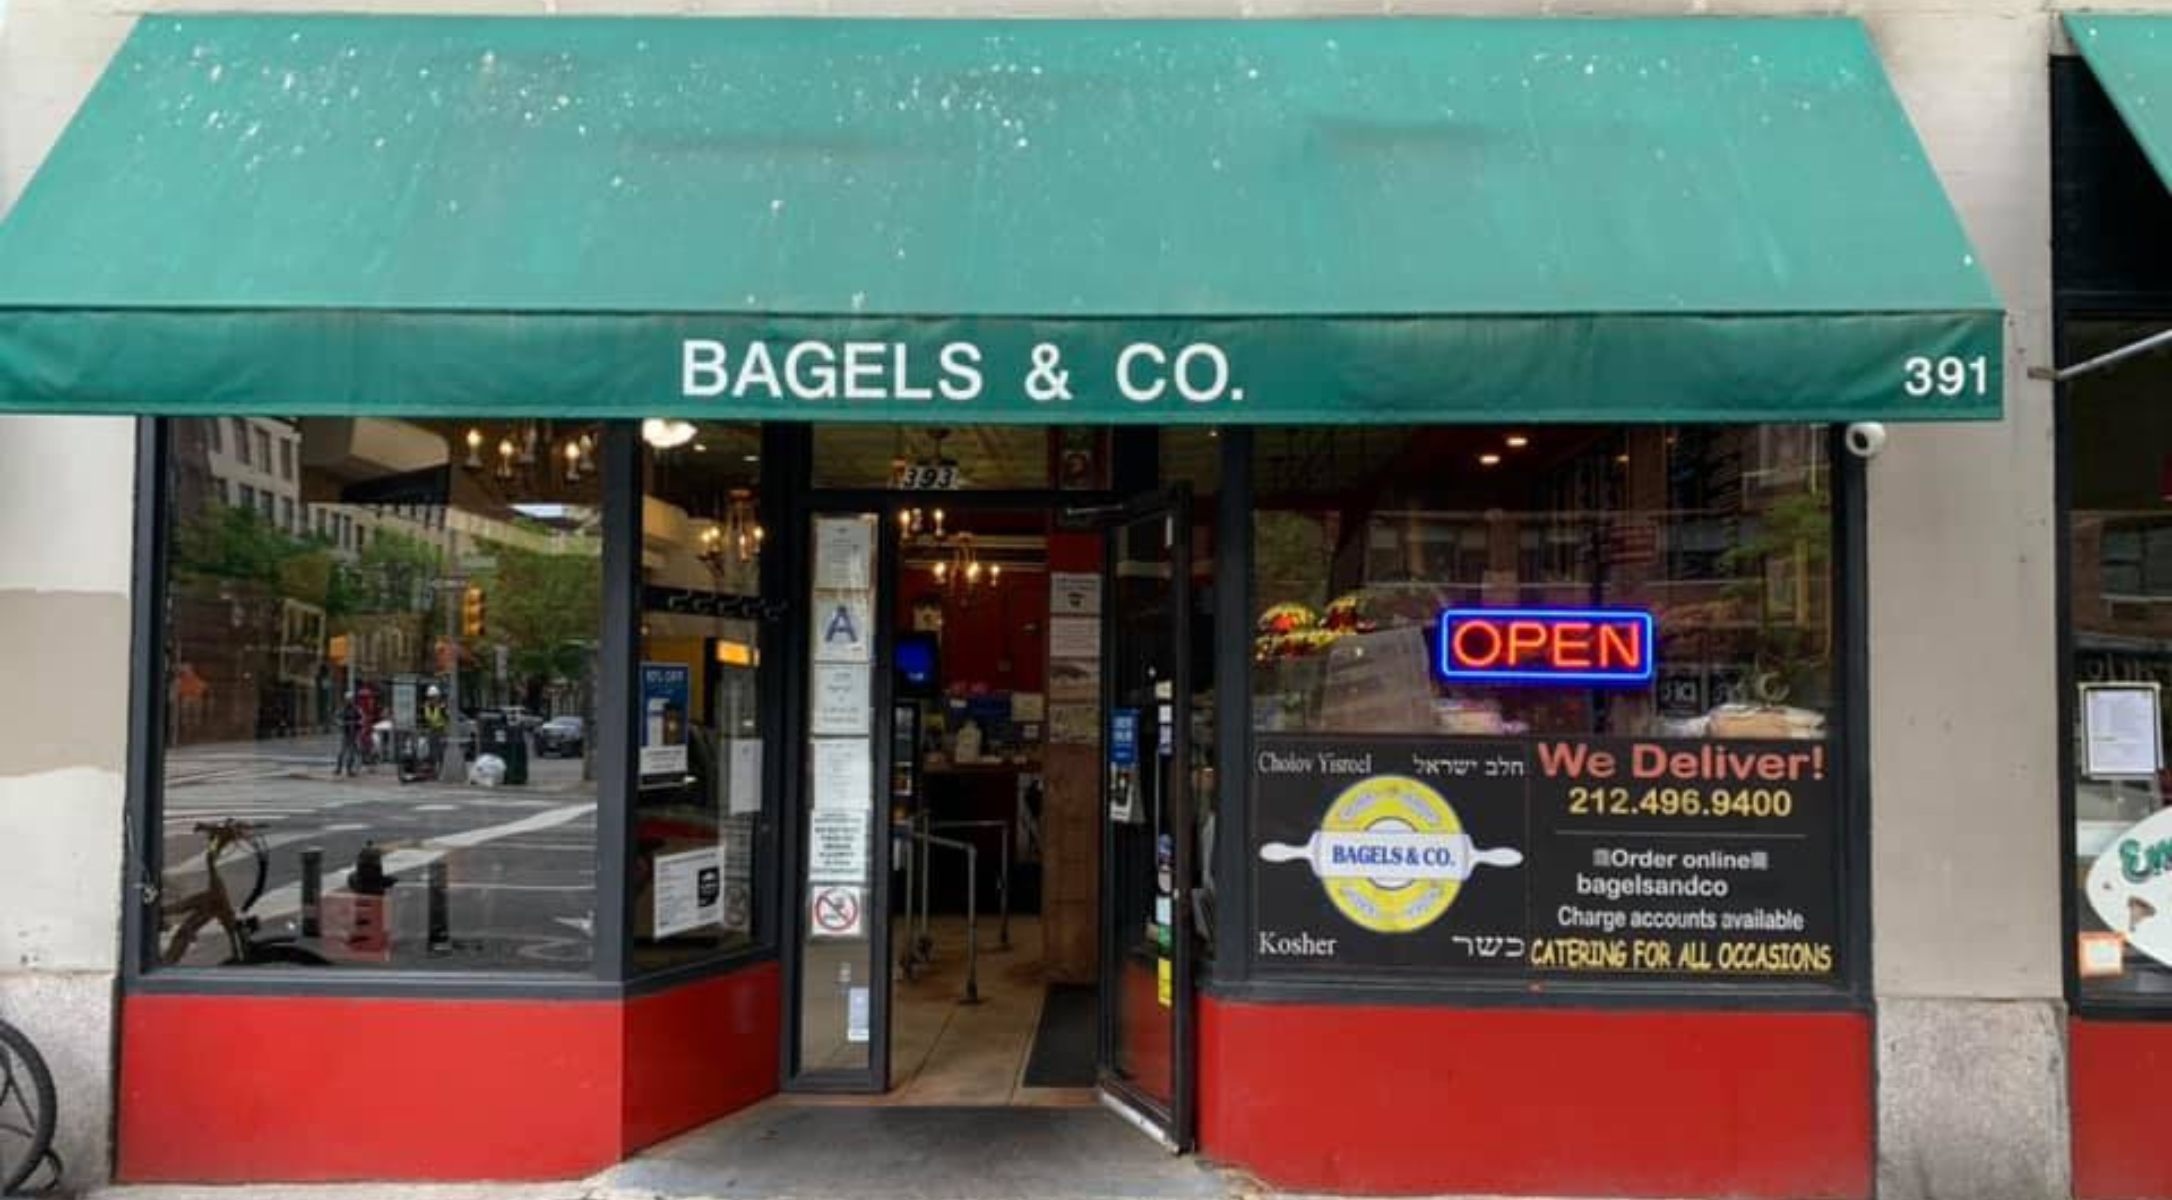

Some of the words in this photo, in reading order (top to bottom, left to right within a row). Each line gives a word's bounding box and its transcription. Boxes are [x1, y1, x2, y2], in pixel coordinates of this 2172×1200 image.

[681, 340, 983, 398] BAGELS
[1024, 343, 1073, 401] &
[1115, 343, 1244, 402] CO.
[1904, 355, 1988, 396] 391
[904, 468, 954, 488] 393
[824, 606, 858, 643] A
[1452, 619, 1641, 668] OPEN
[1411, 752, 1478, 775] ישראל
[1484, 753, 1524, 776] חלב
[1537, 742, 1616, 778] We
[1631, 743, 1826, 780] Deliver!
[1568, 787, 1793, 816] 212.496.9400
[1332, 845, 1402, 865] BAGELS
[1404, 847, 1419, 866] &
[1423, 847, 1455, 867] CO.
[1610, 849, 1677, 868] Order
[1682, 851, 1750, 869] online
[1576, 873, 1729, 900] bagelsandco
[1557, 905, 1626, 932] Charge
[1630, 910, 1717, 931] accounts
[1721, 909, 1804, 931] available
[1259, 932, 1338, 956] Kosher
[1452, 936, 1526, 957] כשר
[1530, 938, 1627, 967] CATERING
[1633, 939, 1671, 968] FOR
[1677, 942, 1712, 969] ALL
[1718, 942, 1832, 971] OCCASIONS
